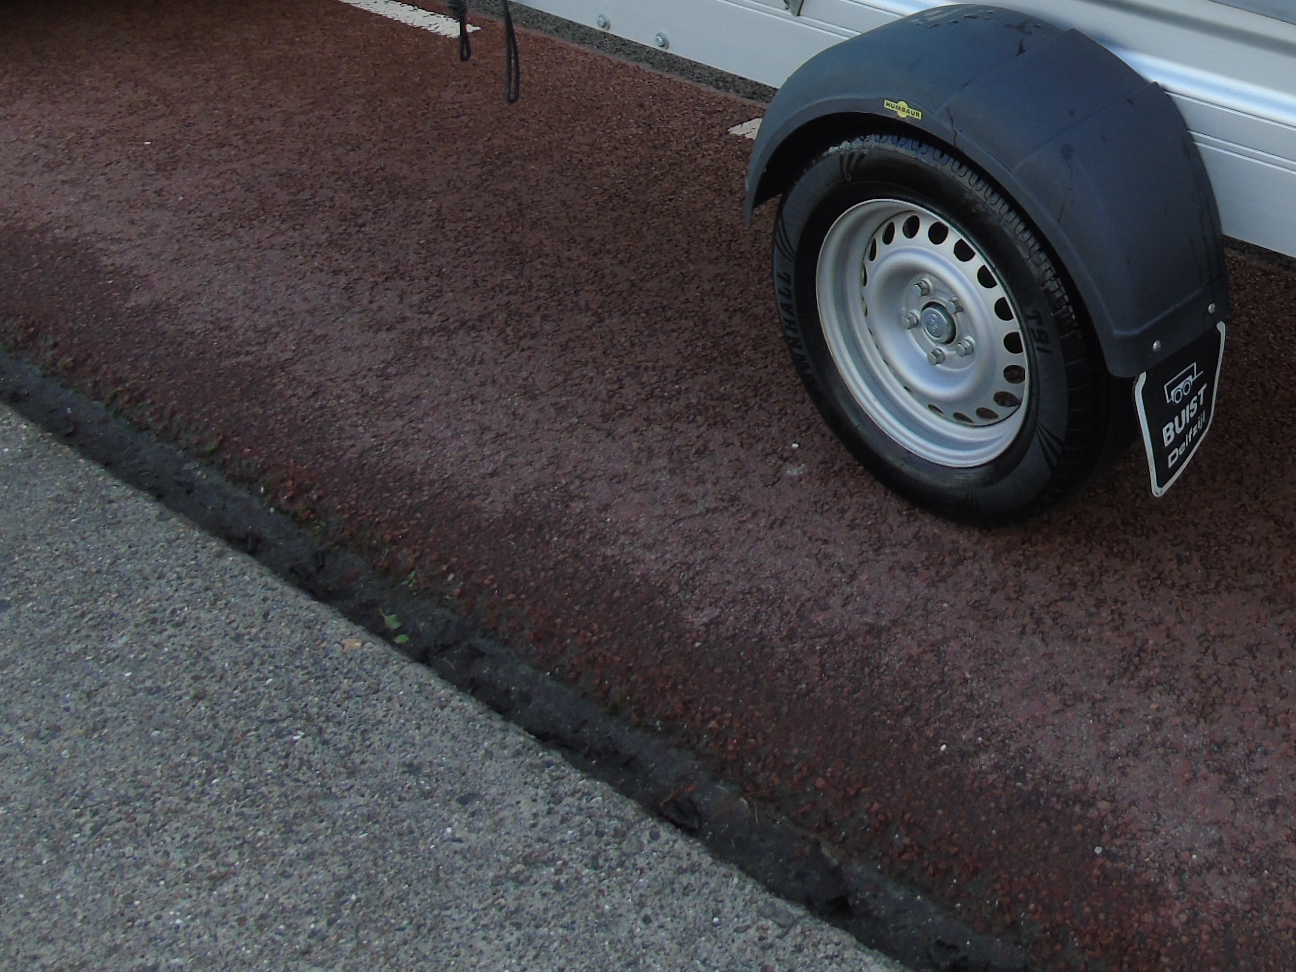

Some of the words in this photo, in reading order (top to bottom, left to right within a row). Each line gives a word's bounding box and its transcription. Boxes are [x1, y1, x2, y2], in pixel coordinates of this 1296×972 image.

[885, 101, 921, 118] HUMBAUR
[1162, 383, 1208, 447] BUIST
[1168, 409, 1206, 469] Delfzijl
